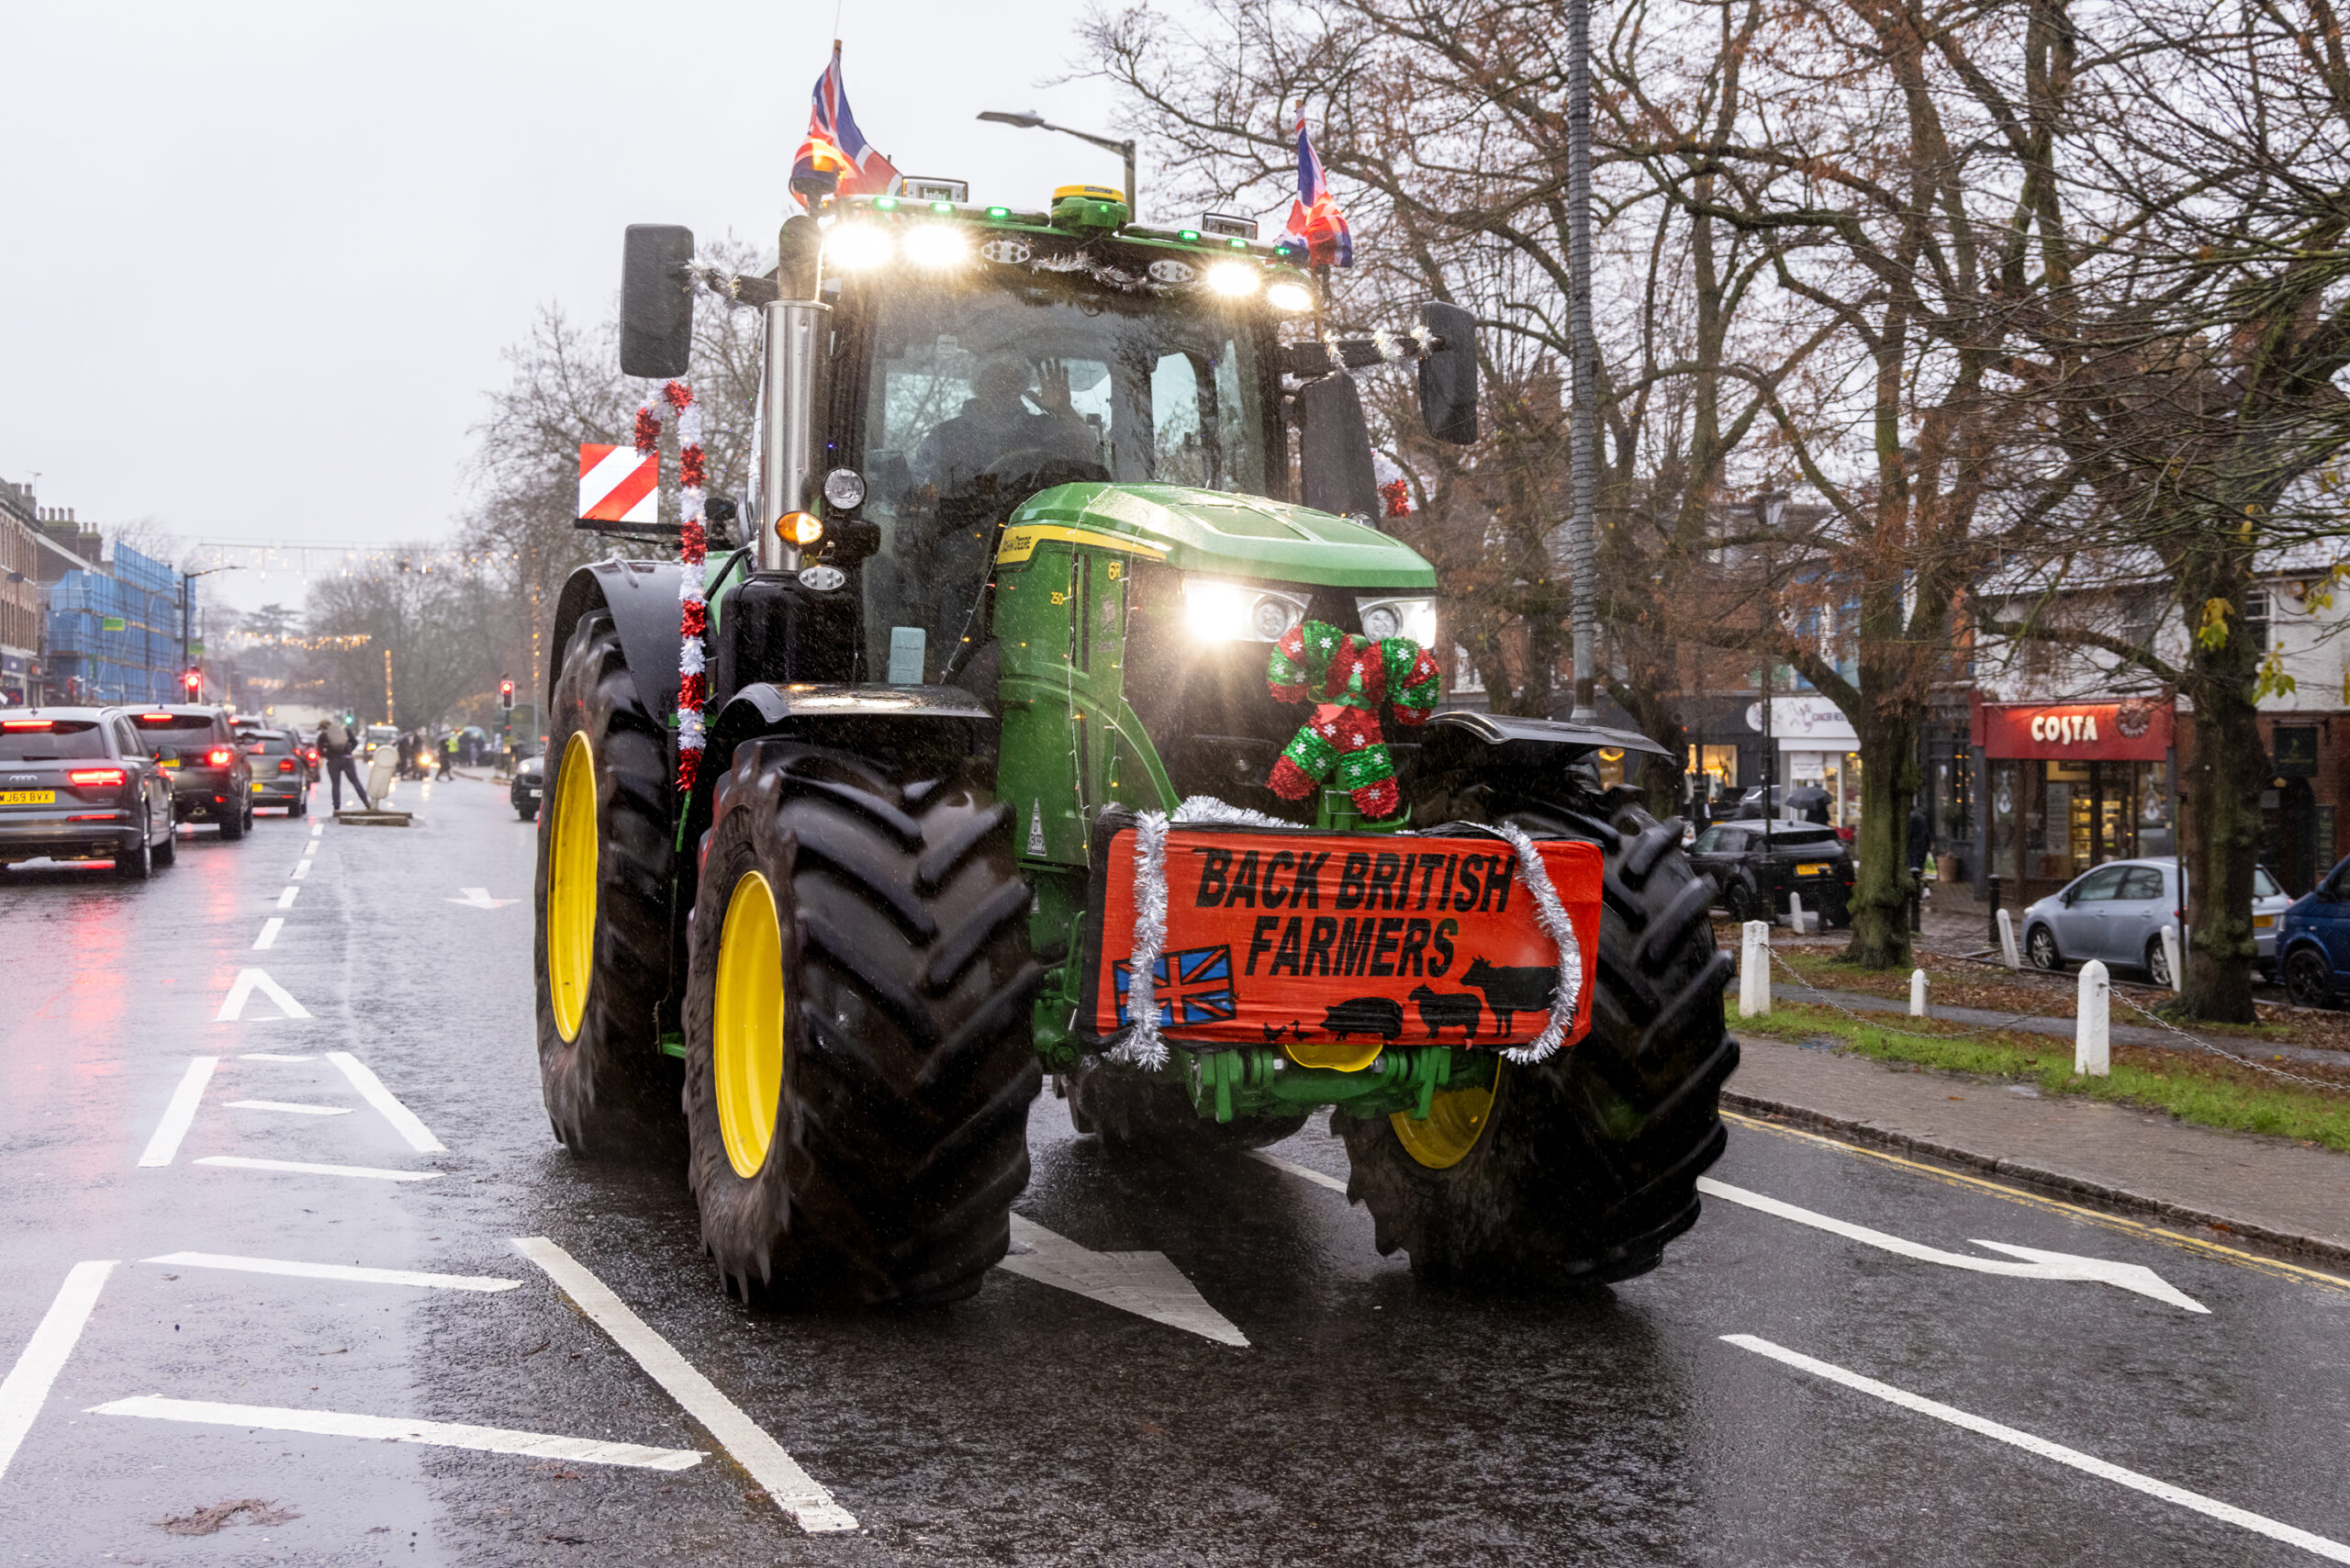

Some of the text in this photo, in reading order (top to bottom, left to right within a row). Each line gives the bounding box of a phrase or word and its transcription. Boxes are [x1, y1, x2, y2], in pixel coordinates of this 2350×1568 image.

[1108, 561, 1122, 581] 6R
[2031, 714, 2098, 745] COSTA
[1194, 851, 1516, 913] BACK BRITISH
[1244, 915, 1459, 979] FARMERS
